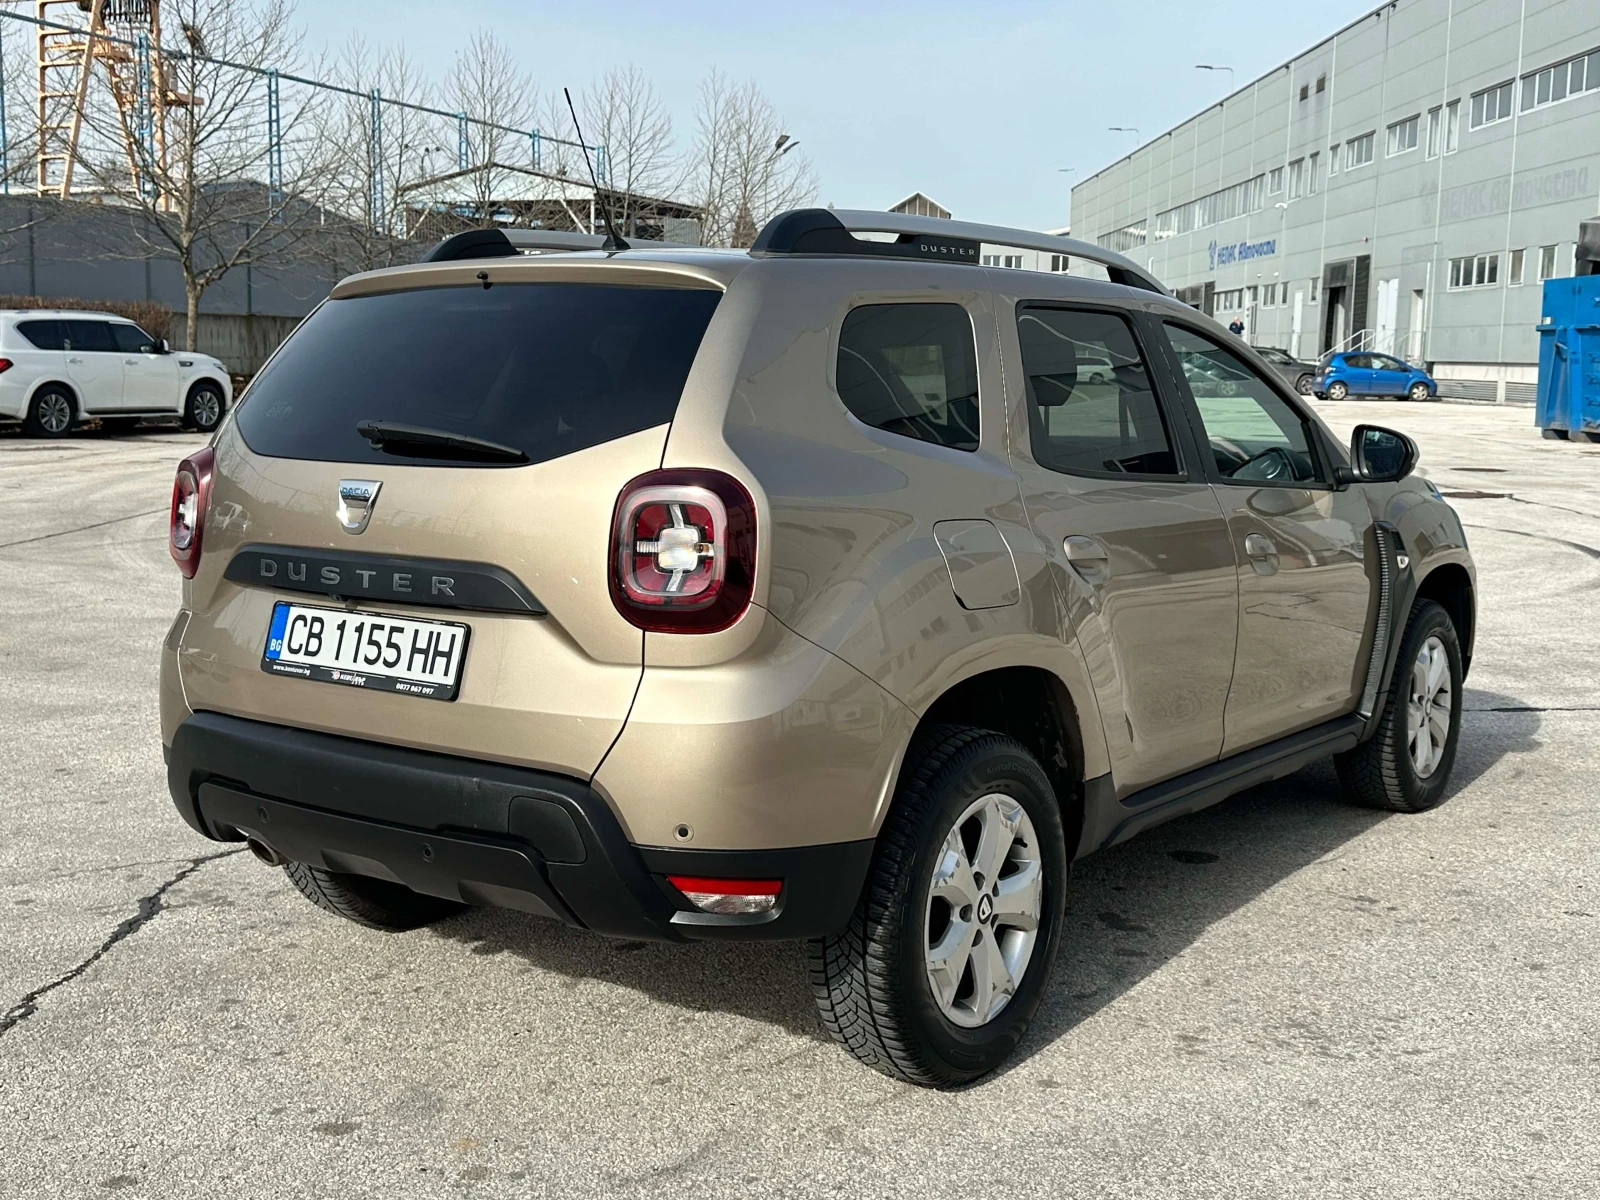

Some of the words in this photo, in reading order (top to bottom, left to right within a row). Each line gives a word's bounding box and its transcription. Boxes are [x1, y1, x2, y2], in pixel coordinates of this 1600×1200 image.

[920, 244, 975, 256] DUSTER
[341, 487, 370, 496] DACIA
[260, 559, 455, 596] DUSTER
[270, 638, 282, 652] BG
[410, 684, 422, 693] 067
